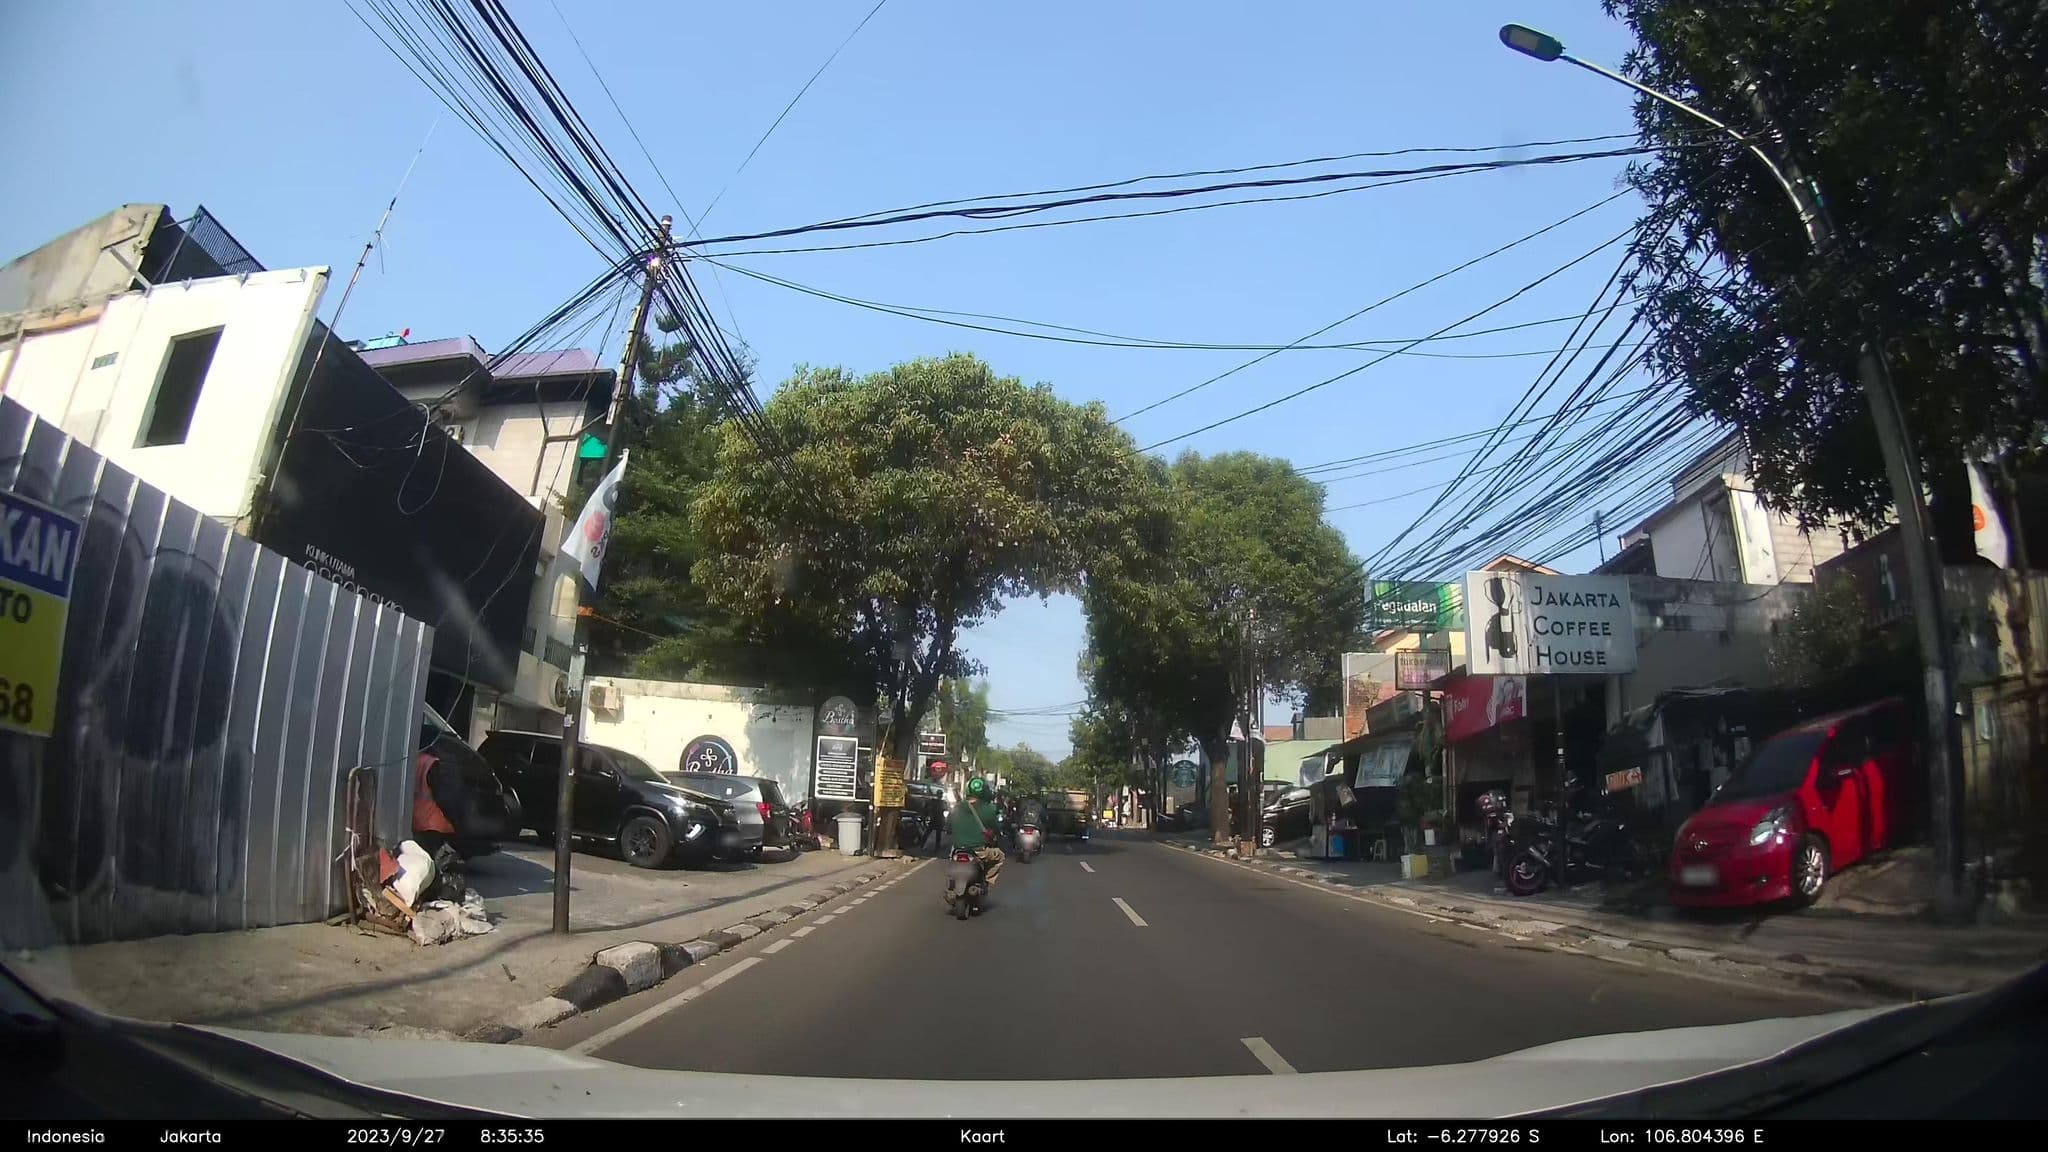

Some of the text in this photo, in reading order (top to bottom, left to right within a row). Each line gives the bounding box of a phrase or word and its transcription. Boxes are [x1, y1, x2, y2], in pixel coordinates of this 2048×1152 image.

[1531, 586, 1620, 607] JAKARTA
[1534, 615, 1612, 636] COFFEE
[1536, 645, 1607, 667] HOUSE
